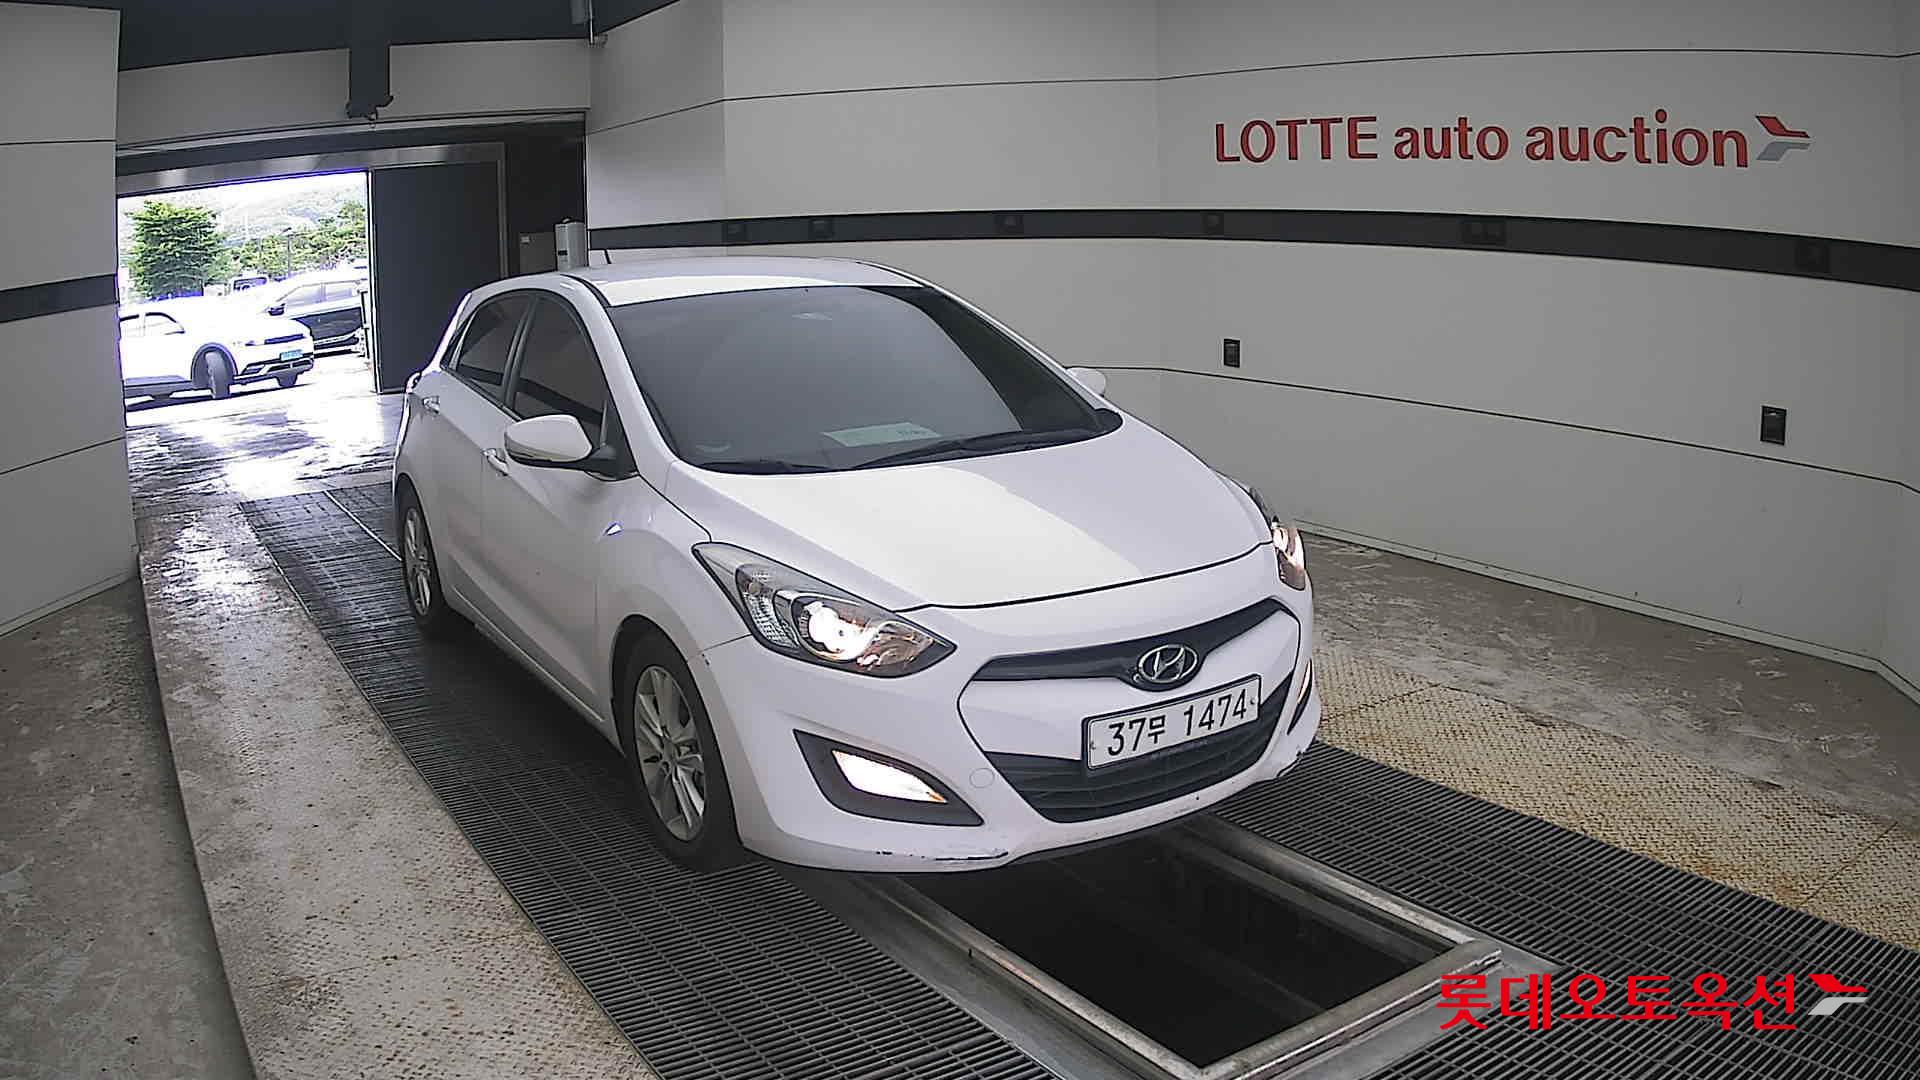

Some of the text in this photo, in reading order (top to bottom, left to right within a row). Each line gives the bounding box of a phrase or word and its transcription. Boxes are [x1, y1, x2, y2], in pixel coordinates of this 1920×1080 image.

[1215, 108, 1749, 168] LOTTE auto auction
[1107, 688, 1247, 756] 37무 1474
